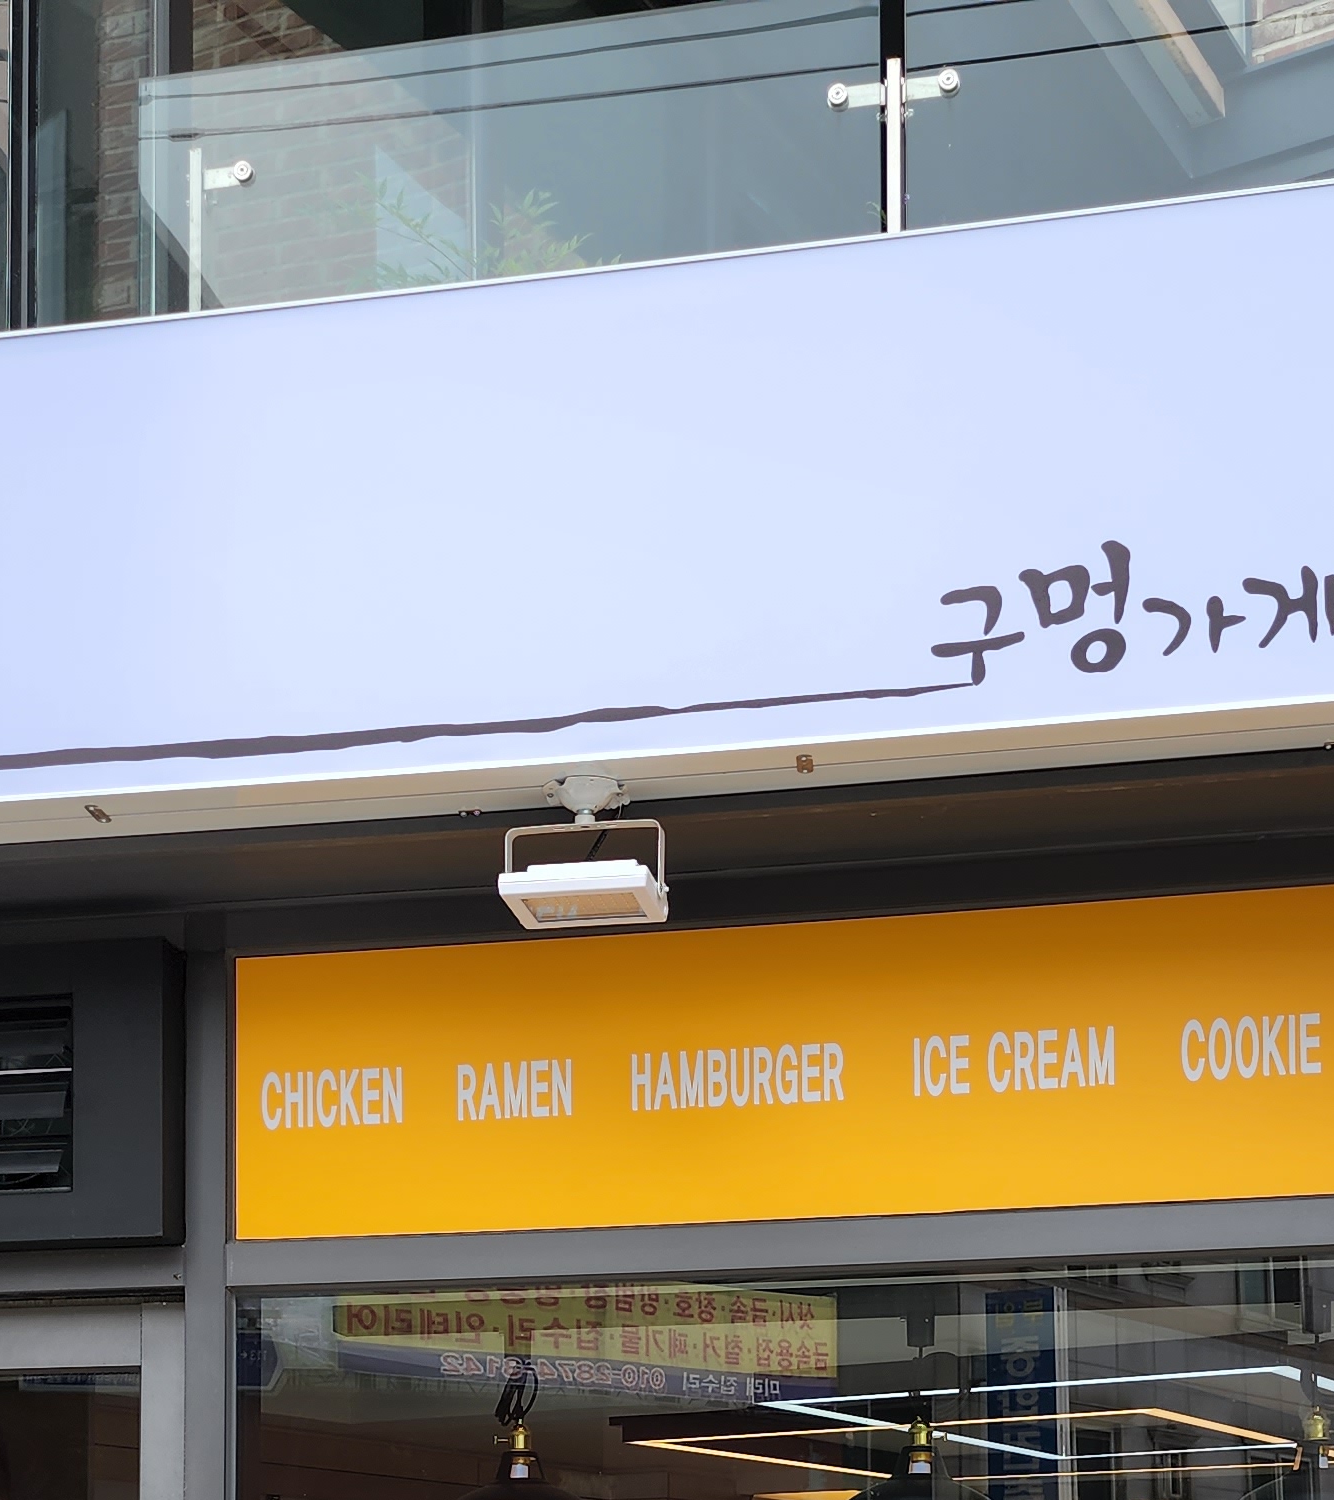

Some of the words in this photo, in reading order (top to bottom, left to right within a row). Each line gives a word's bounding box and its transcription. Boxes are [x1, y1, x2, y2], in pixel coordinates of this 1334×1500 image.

[630, 1042, 846, 1112] HAMBURGER
[911, 1034, 970, 1097] ICE
[986, 1025, 1116, 1090] CREAM
[1179, 1012, 1323, 1082] COOKIE
[260, 1067, 404, 1131] CHICKEN
[456, 1059, 573, 1121] RAMEN
